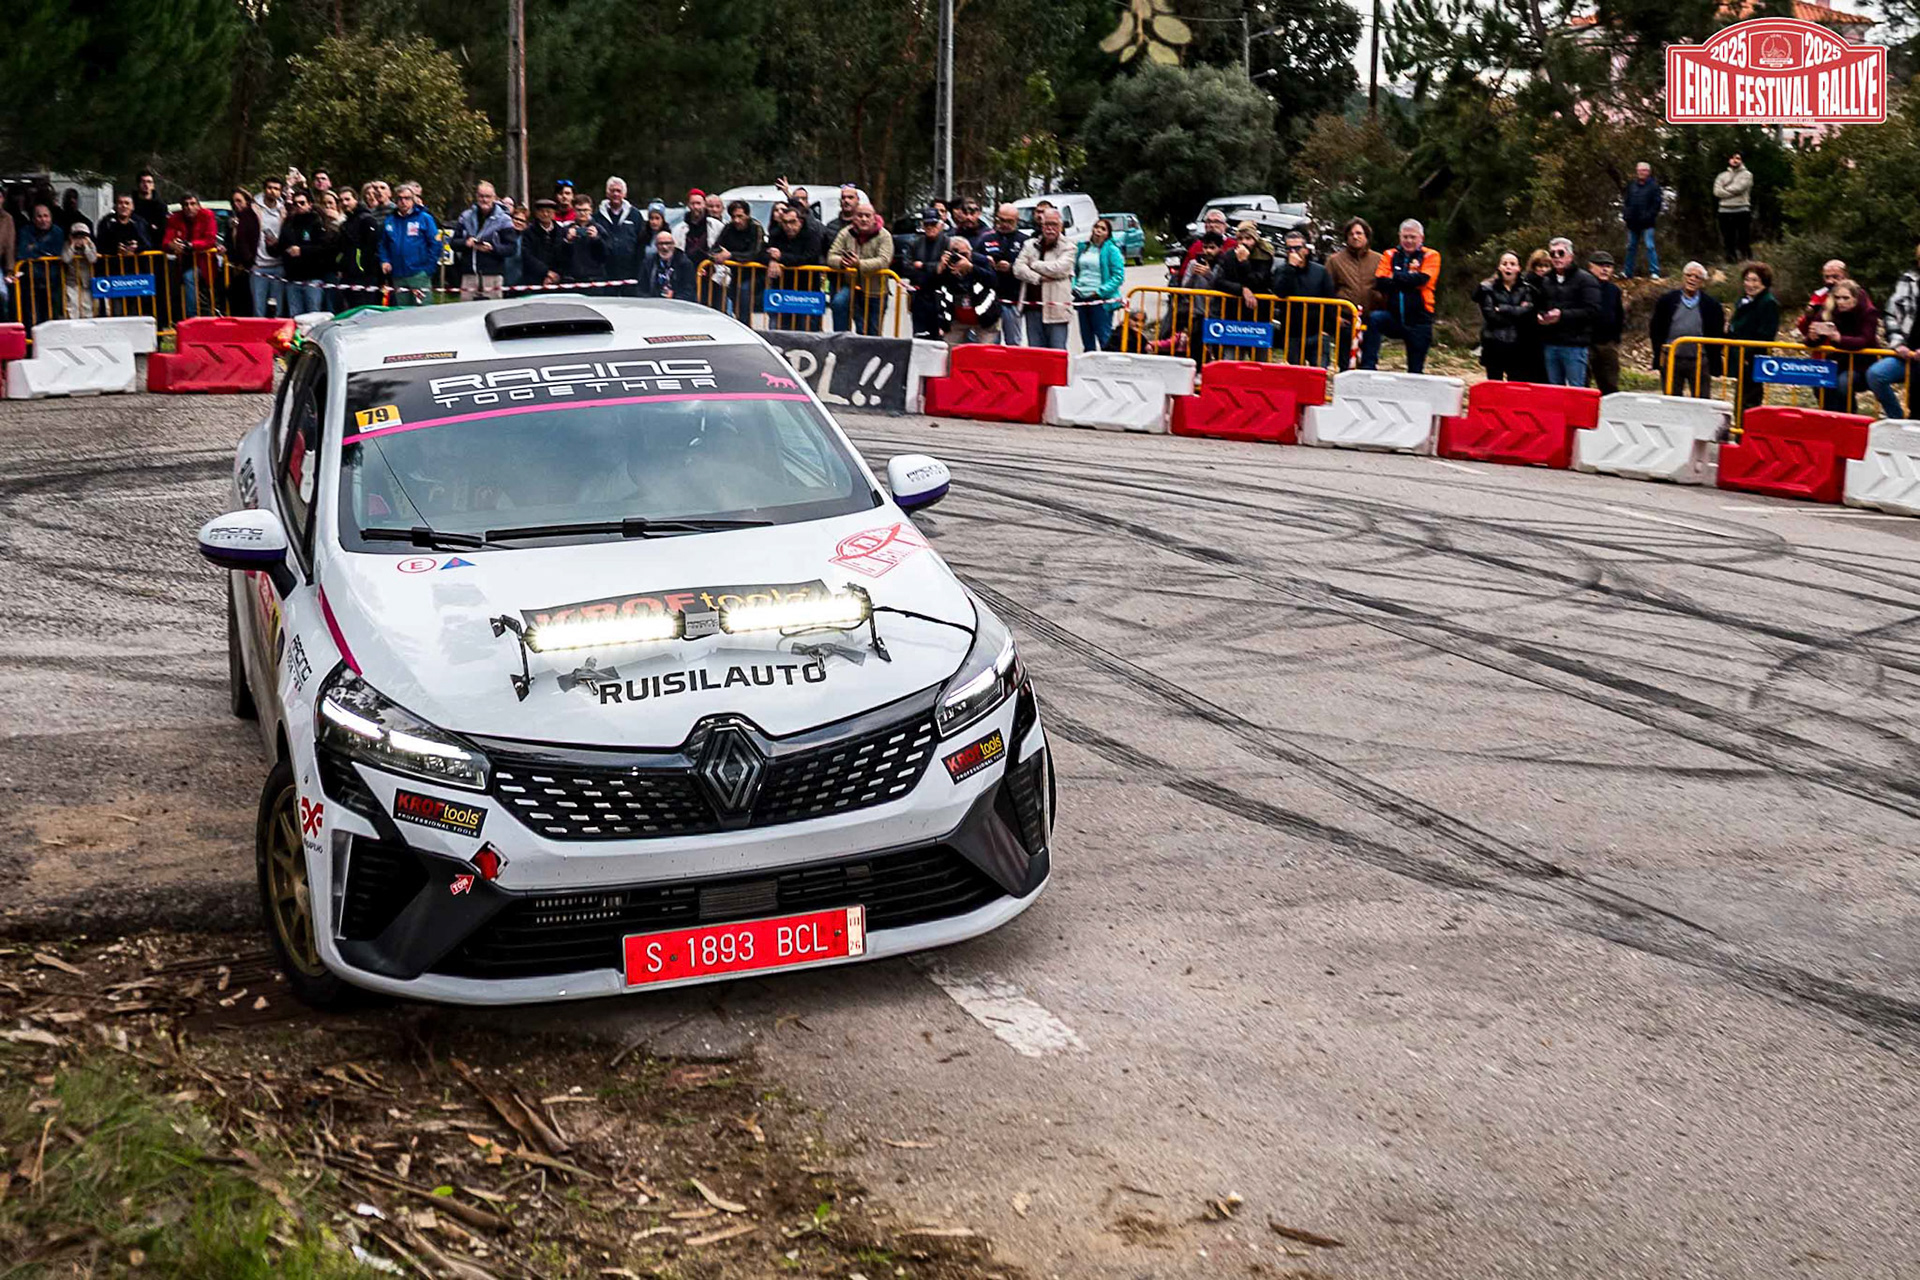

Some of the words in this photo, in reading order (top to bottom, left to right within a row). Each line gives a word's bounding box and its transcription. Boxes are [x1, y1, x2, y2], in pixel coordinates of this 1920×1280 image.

[429, 359, 713, 395] RACING
[1781, 361, 1830, 374] Oliveiras
[435, 377, 719, 409] TOGETHER
[362, 408, 389, 425] 79
[600, 662, 827, 704] RUISILAUTO
[398, 812, 450, 830] PROFESSIONAL
[453, 826, 477, 836] TOOLS
[647, 942, 663, 973] S
[687, 931, 754, 967] 1893
[777, 922, 829, 957] BCL
